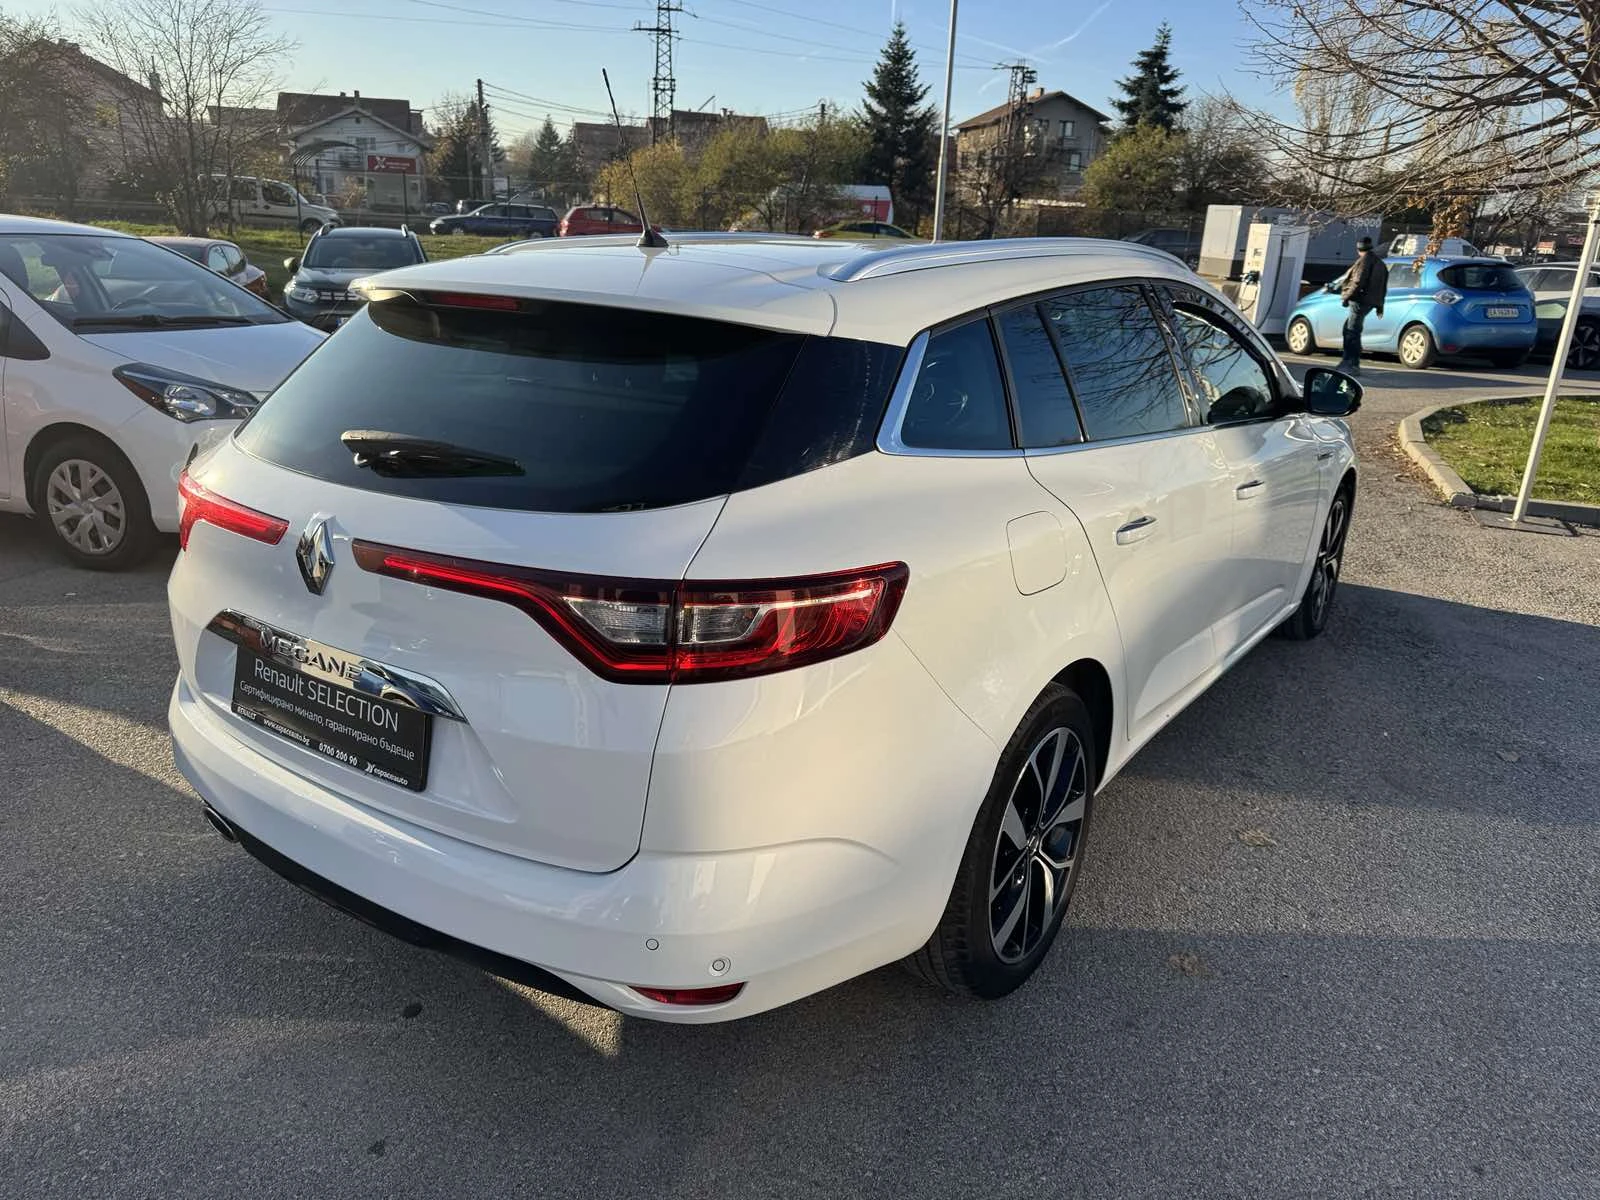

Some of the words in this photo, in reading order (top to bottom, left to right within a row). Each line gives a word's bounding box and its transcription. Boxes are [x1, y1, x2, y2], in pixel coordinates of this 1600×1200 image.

[260, 630, 363, 682] MEGANE
[240, 680, 294, 712] Сертифицирано
[294, 705, 325, 727] минало,
[325, 718, 379, 746] гарантирано
[379, 737, 415, 761] бъдеще
[254, 658, 304, 697] Renault
[307, 680, 399, 732] SELECTION
[318, 743, 335, 756] 0700
[335, 750, 348, 762] 200
[349, 756, 358, 766] 90
[373, 767, 409, 786] espaceauto
